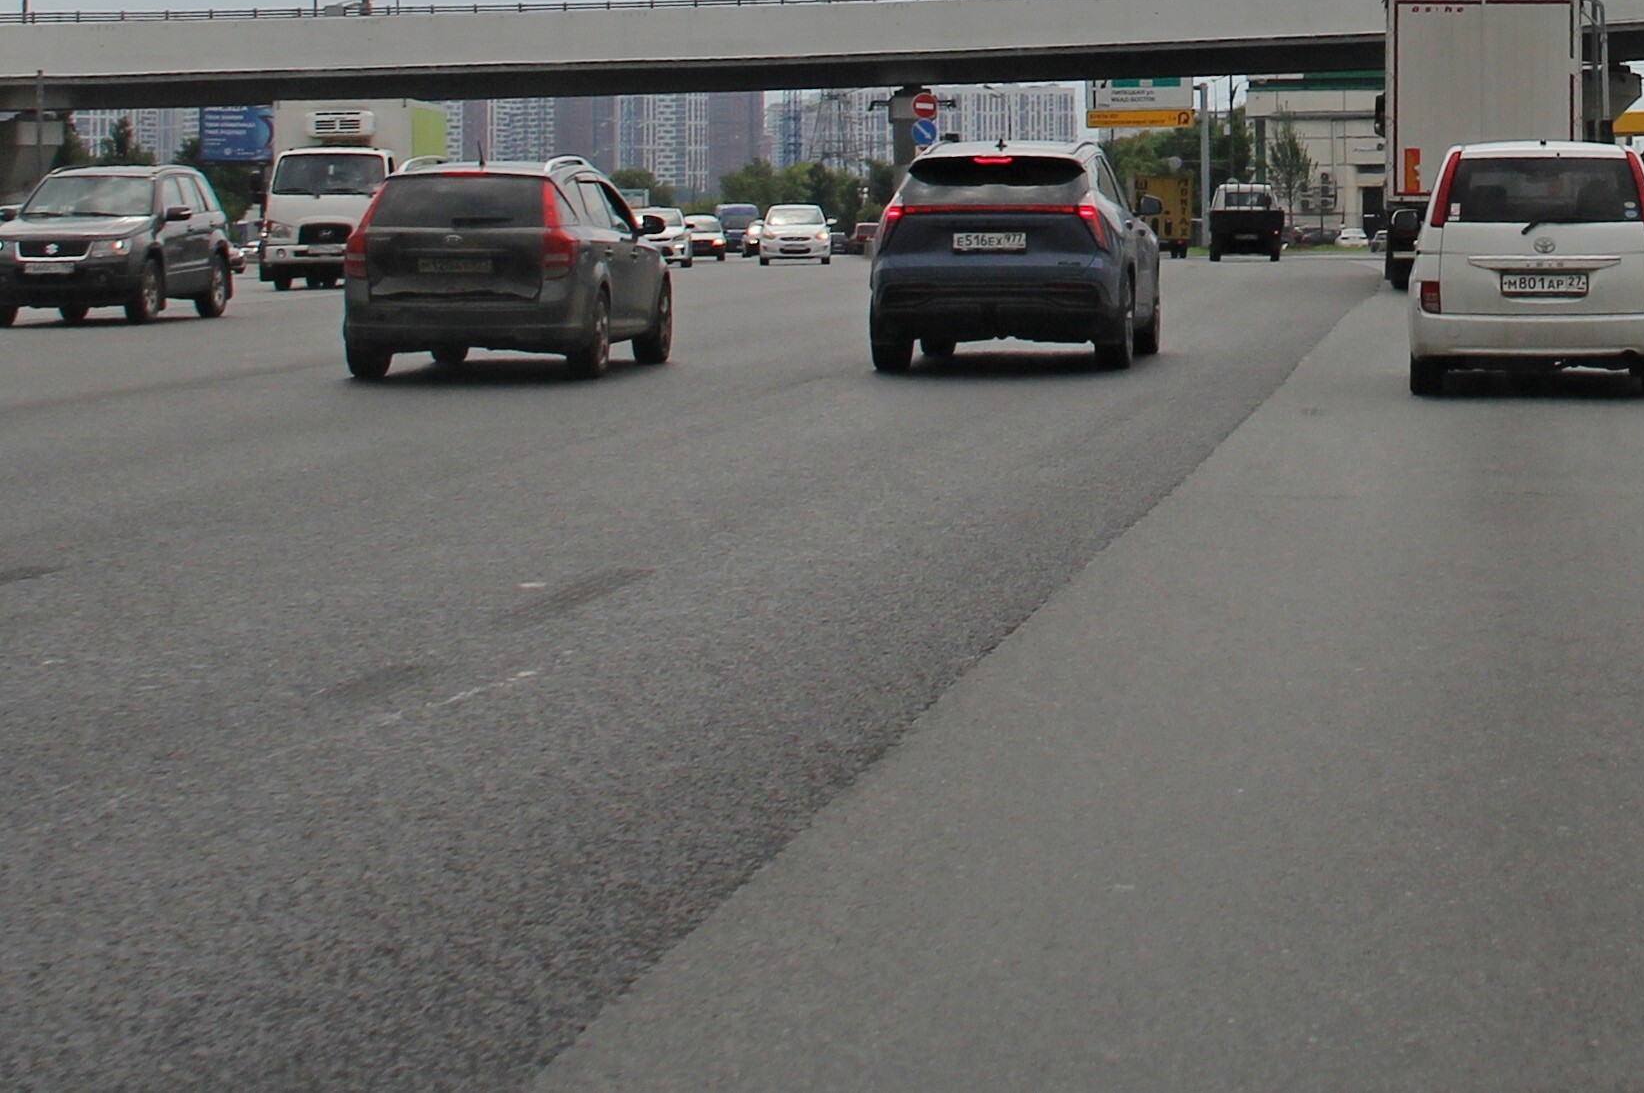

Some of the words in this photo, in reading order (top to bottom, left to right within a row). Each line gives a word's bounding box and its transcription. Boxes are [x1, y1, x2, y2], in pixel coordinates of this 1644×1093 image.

[956, 234, 1003, 247] Е516ЕХ
[1004, 233, 1023, 243] 977
[1507, 276, 1564, 290] М801АР
[1568, 276, 1582, 287] 27
